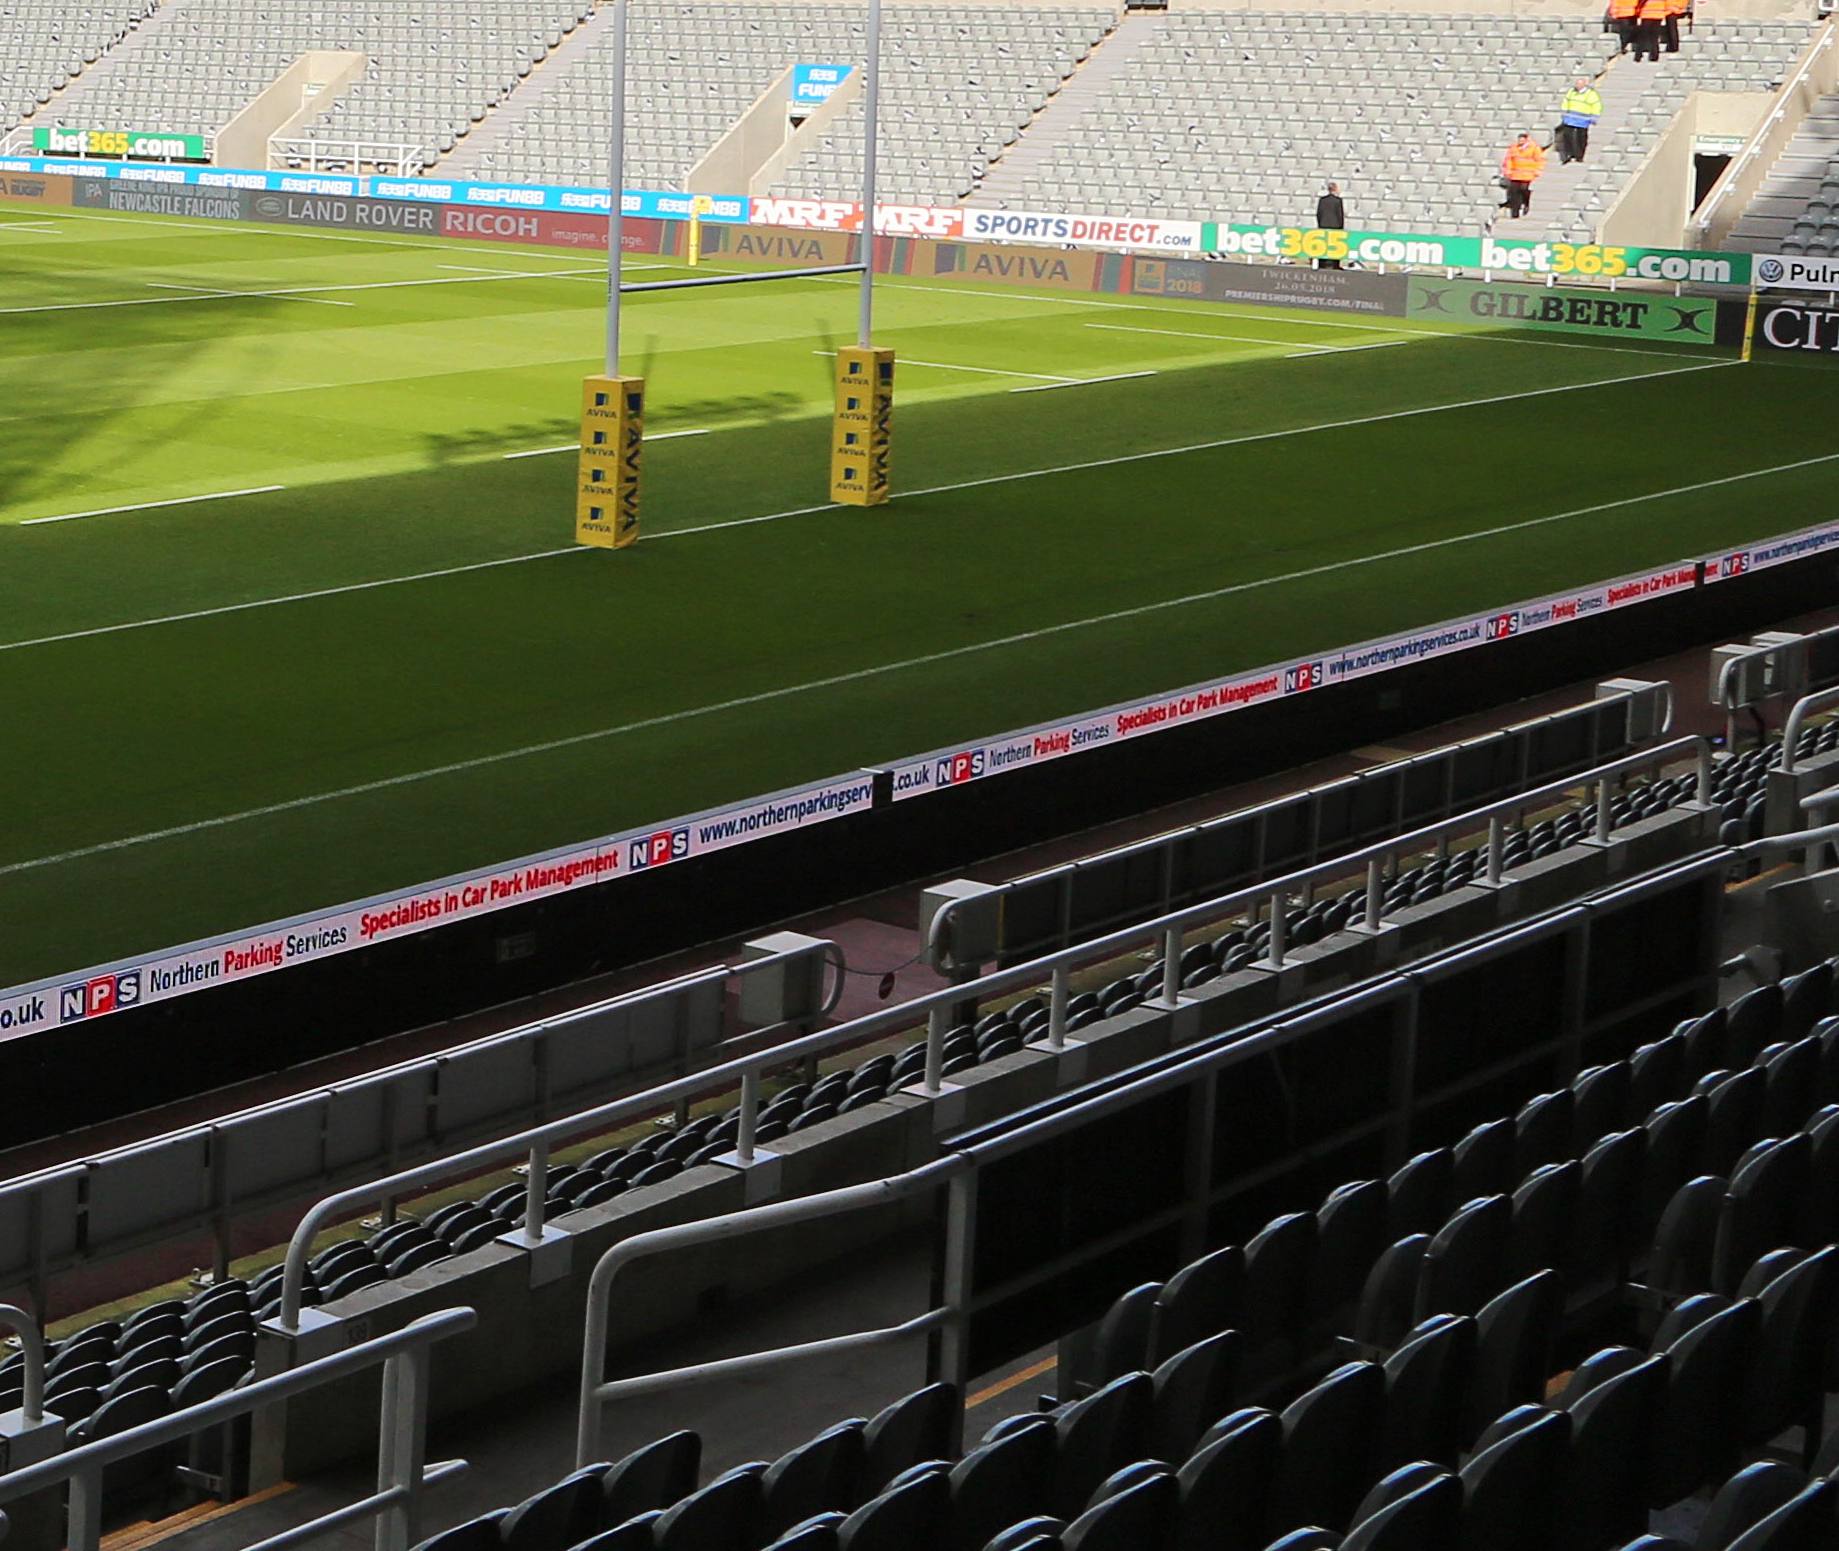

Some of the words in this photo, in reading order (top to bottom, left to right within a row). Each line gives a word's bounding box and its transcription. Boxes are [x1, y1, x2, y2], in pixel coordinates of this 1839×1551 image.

[49, 129, 186, 157] bet365.com
[110, 191, 182, 215] NEWCASTLE
[184, 197, 240, 220] FALCONS
[287, 199, 347, 223] LAND
[355, 203, 434, 229] ROVER
[750, 198, 853, 231] MRF
[444, 210, 538, 237] RICOH
[974, 214, 1192, 246] SPORTSDIRECT.COM
[551, 229, 599, 245] imagine.
[602, 233, 646, 247] cnge.
[736, 234, 824, 260] AVIVA
[1217, 223, 1444, 264] bet365.com
[973, 253, 1069, 281] AVIVA
[1481, 238, 1731, 282] bet365.com
[1166, 279, 1203, 294] 2018
[1470, 292, 1648, 331] GILBERT
[840, 376, 870, 386] AVIVA
[587, 408, 618, 419] AVIVA
[838, 412, 868, 421] AVIVA
[585, 447, 616, 457] AVIVA
[837, 447, 866, 457] AVIVA
[874, 394, 890, 490] AVIVA
[583, 485, 614, 495] AVIVA
[622, 427, 640, 532] AVIVA
[835, 482, 864, 492] AVIVA
[581, 523, 611, 534] AVIVA
[63, 972, 140, 1022] NPS
[150, 959, 220, 993] Northern
[224, 940, 283, 974] Parking
[286, 925, 347, 957] Services
[360, 898, 441, 939] Specialists
[445, 893, 458, 913] in
[462, 884, 486, 907] Car
[490, 873, 523, 902] Park
[525, 849, 619, 892] Management
[631, 829, 688, 870] NPS
[699, 764, 930, 844] www.northernparkingserv.co.uk
[937, 752, 983, 786] NPS
[989, 744, 1031, 768] Northern
[1034, 732, 1070, 756] Parking
[1071, 723, 1110, 746] Services
[1117, 704, 1167, 734] Specialists
[1197, 692, 1217, 712] Park
[1286, 663, 1322, 693] NPS
[1486, 613, 1519, 640] NPS
